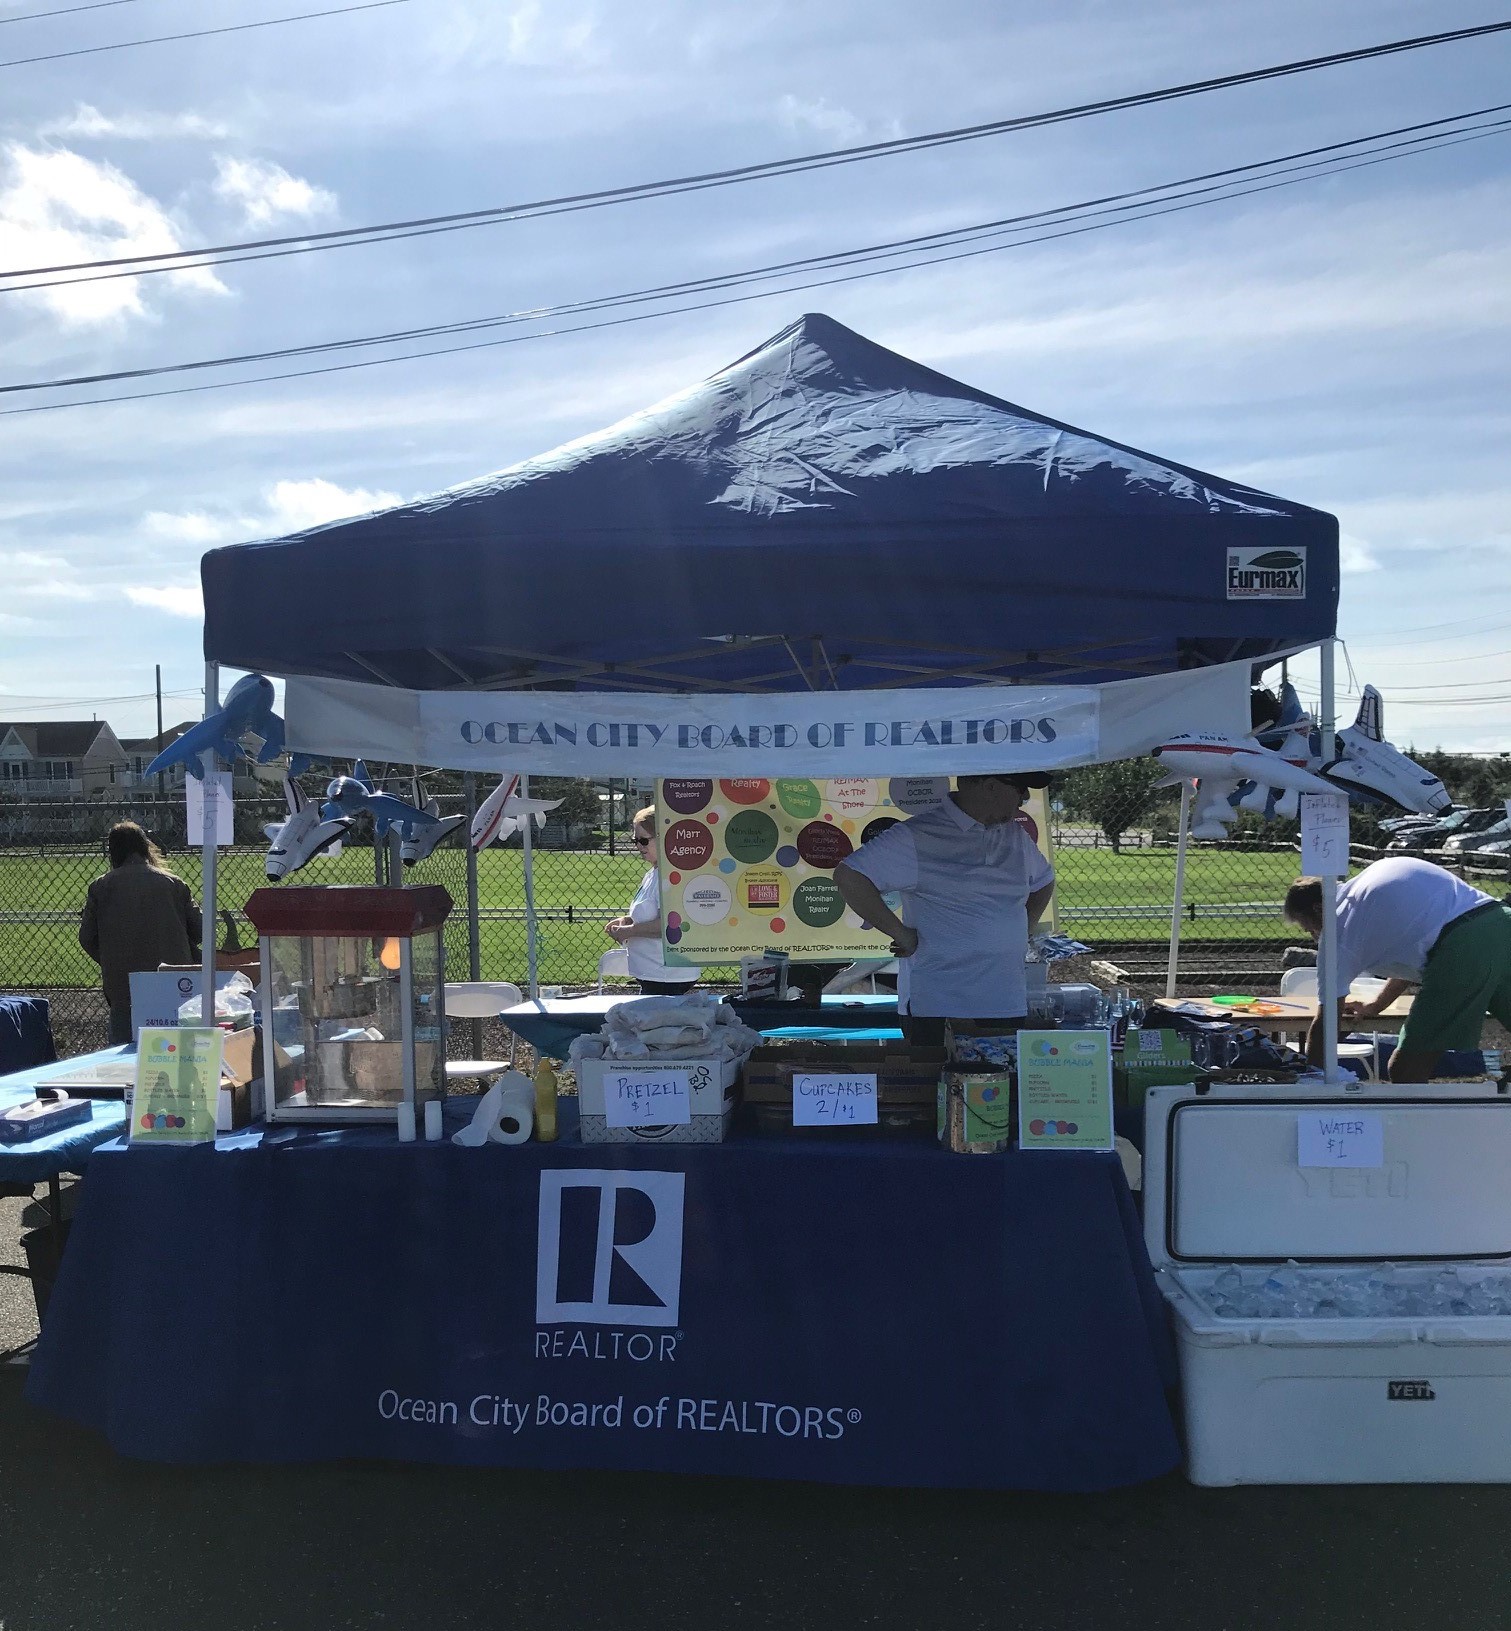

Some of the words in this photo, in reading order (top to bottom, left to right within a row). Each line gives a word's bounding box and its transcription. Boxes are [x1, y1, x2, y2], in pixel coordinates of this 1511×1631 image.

[1229, 567, 1299, 588] Eurmax
[460, 719, 577, 746] OCEAN
[586, 722, 668, 749] CITY
[678, 723, 798, 750] BOARD
[807, 721, 855, 748] OF
[863, 716, 1057, 747] REALTORS
[731, 779, 761, 789] Realty
[782, 784, 808, 792] Grace
[675, 791, 700, 799] Realtors
[838, 788, 850, 797] At
[850, 788, 867, 797] The
[842, 801, 865, 810] Shore
[676, 828, 701, 840] Marr
[670, 846, 707, 856] Agency
[680, 946, 710, 954] Sponsored
[617, 1077, 684, 1099] PRETZEL
[800, 1077, 873, 1096] CUPCAKES
[1319, 1119, 1364, 1136] WATER
[1391, 1384, 1432, 1397] YETI
[378, 1389, 458, 1425] Ocean
[469, 1394, 531, 1435] City
[535, 1394, 623, 1428] Board
[632, 1396, 668, 1428] of
[677, 1398, 863, 1440] REALTORS®
